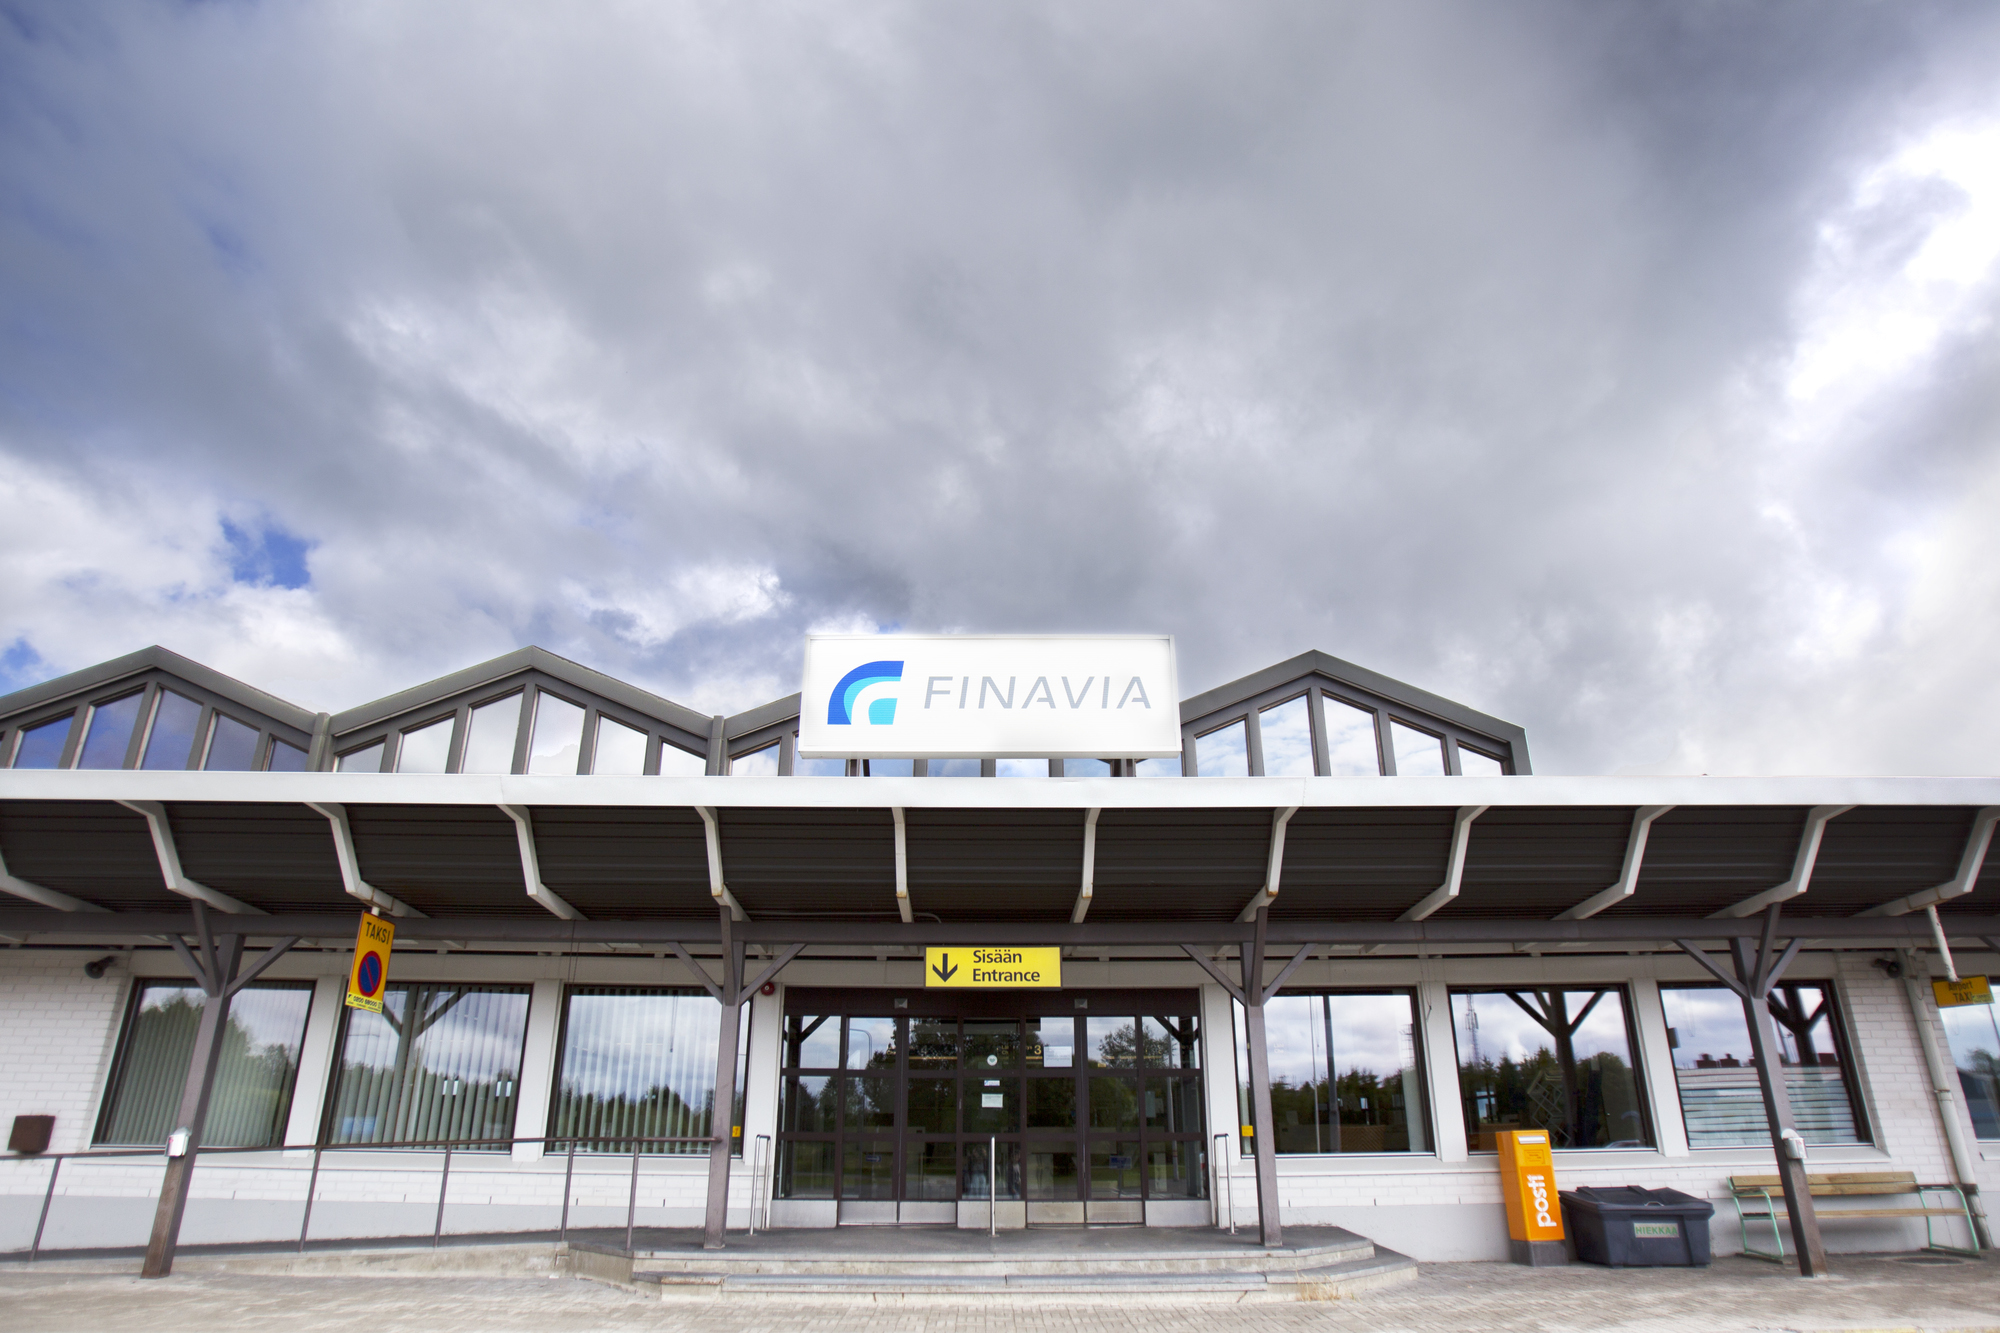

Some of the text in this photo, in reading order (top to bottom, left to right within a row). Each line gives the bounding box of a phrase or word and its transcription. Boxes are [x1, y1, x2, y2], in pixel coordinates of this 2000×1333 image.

[924, 676, 1151, 709] FINAVIA
[366, 922, 391, 945] TAKSI
[973, 949, 1022, 963] Sisään
[973, 968, 1040, 982] Entrance
[1953, 991, 1973, 1003] TAXI
[1034, 1044, 1042, 1055] 3
[1527, 1174, 1557, 1227] posti
[1635, 1226, 1678, 1235] HIEKKAA
